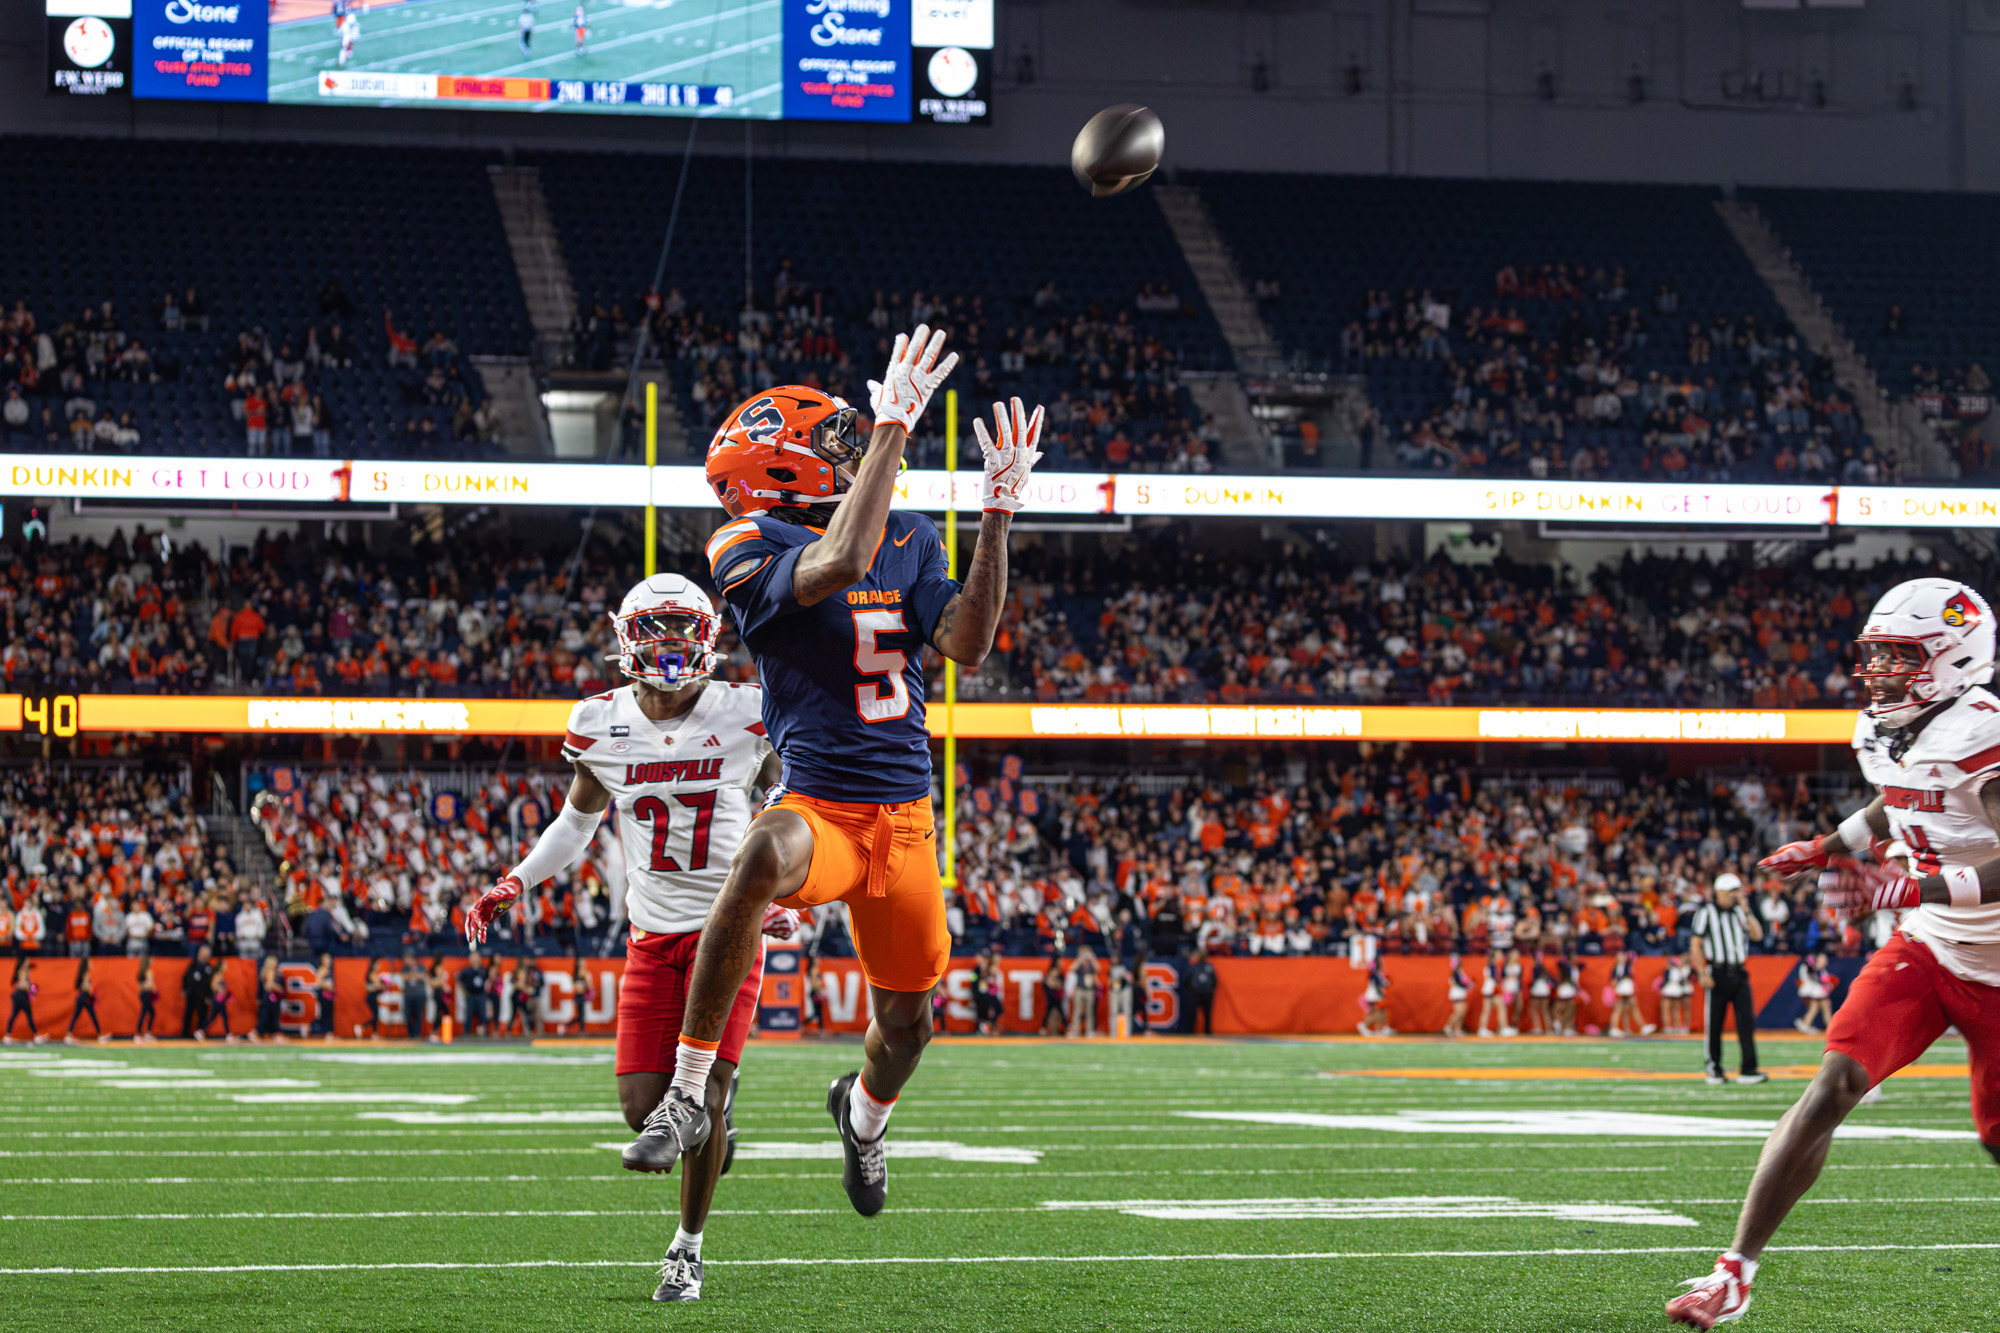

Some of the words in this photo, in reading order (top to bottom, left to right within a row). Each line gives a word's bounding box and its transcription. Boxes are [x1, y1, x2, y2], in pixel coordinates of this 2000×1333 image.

[806, 0, 890, 18] urning
[810, 12, 883, 46] Stone
[557, 80, 585, 103] 2ND
[738, 397, 785, 443] S
[152, 469, 208, 488] GET
[224, 470, 309, 490] LOUD
[425, 474, 528, 492] DUNKIN
[1185, 487, 1283, 505] DUNKIN
[1486, 491, 1524, 509] SIP
[1538, 492, 1642, 511] DUNKIN
[1662, 495, 1711, 513] GET
[1726, 496, 1801, 515] LOUD
[1904, 499, 1996, 516] DUNKIN
[852, 609, 910, 723] 5
[24, 695, 77, 737] 40
[624, 758, 725, 785] LOUISVILLE
[633, 789, 717, 872] 27
